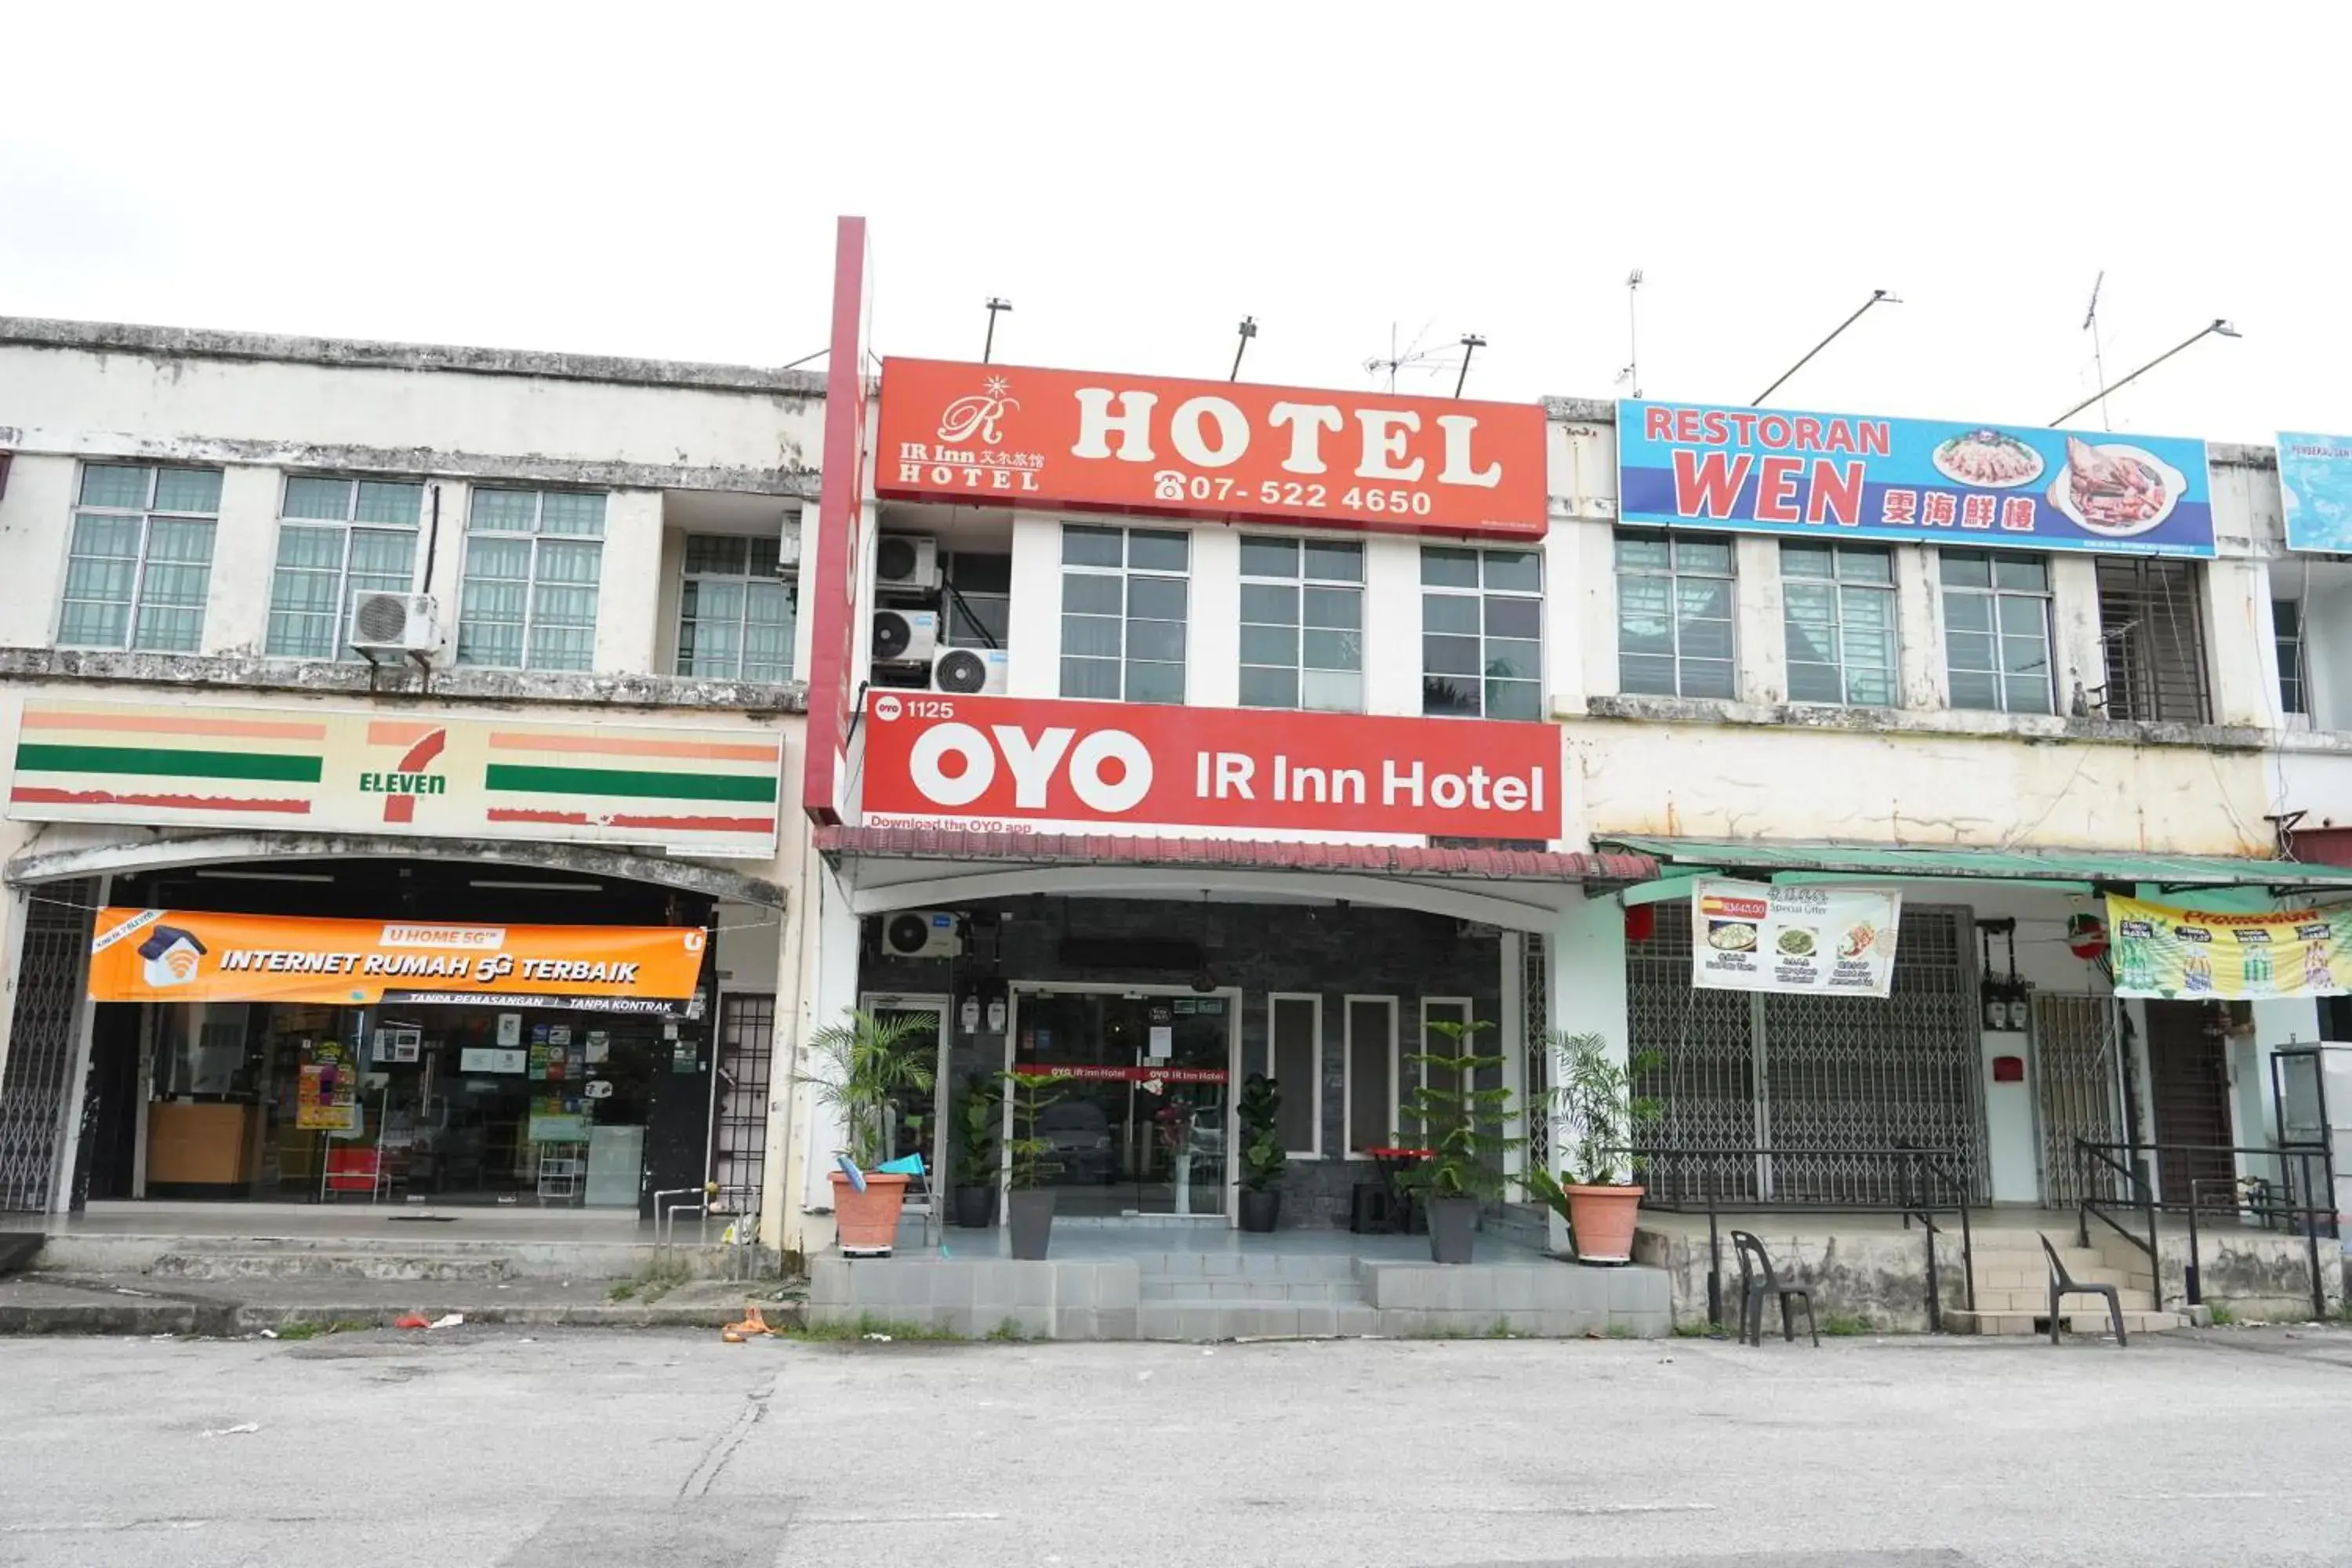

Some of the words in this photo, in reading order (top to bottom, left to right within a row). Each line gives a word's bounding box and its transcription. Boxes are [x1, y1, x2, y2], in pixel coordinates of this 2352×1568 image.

[1071, 387, 1501, 488] HOTEL
[1645, 406, 1890, 456] RESTORAN
[900, 442, 928, 460] IR
[935, 445, 975, 463] Inn
[898, 463, 1039, 491] HOTEL
[1671, 449, 1866, 526] WEN
[1260, 481, 1327, 507] 522
[1341, 486, 1432, 515] 4650
[1882, 488, 2035, 531] 雯海鮮樓
[907, 700, 954, 719] 1125
[367, 721, 446, 823] 7
[909, 722, 1153, 812] OYO
[1196, 751, 1255, 799] IR
[1273, 754, 1365, 804] Inn
[1382, 760, 1544, 812] Hotel
[870, 815, 941, 829] Download
[970, 820, 1003, 832] OYO
[390, 929, 403, 942] U
[405, 931, 460, 943] HOME
[220, 949, 361, 975] INTERNET
[363, 953, 470, 978] RUMAH
[474, 952, 514, 983] 5G
[521, 958, 640, 984] TERBAIK
[408, 993, 452, 1003] TANPA
[568, 998, 610, 1011] TANPA
[612, 1000, 673, 1012] KONTRAK
